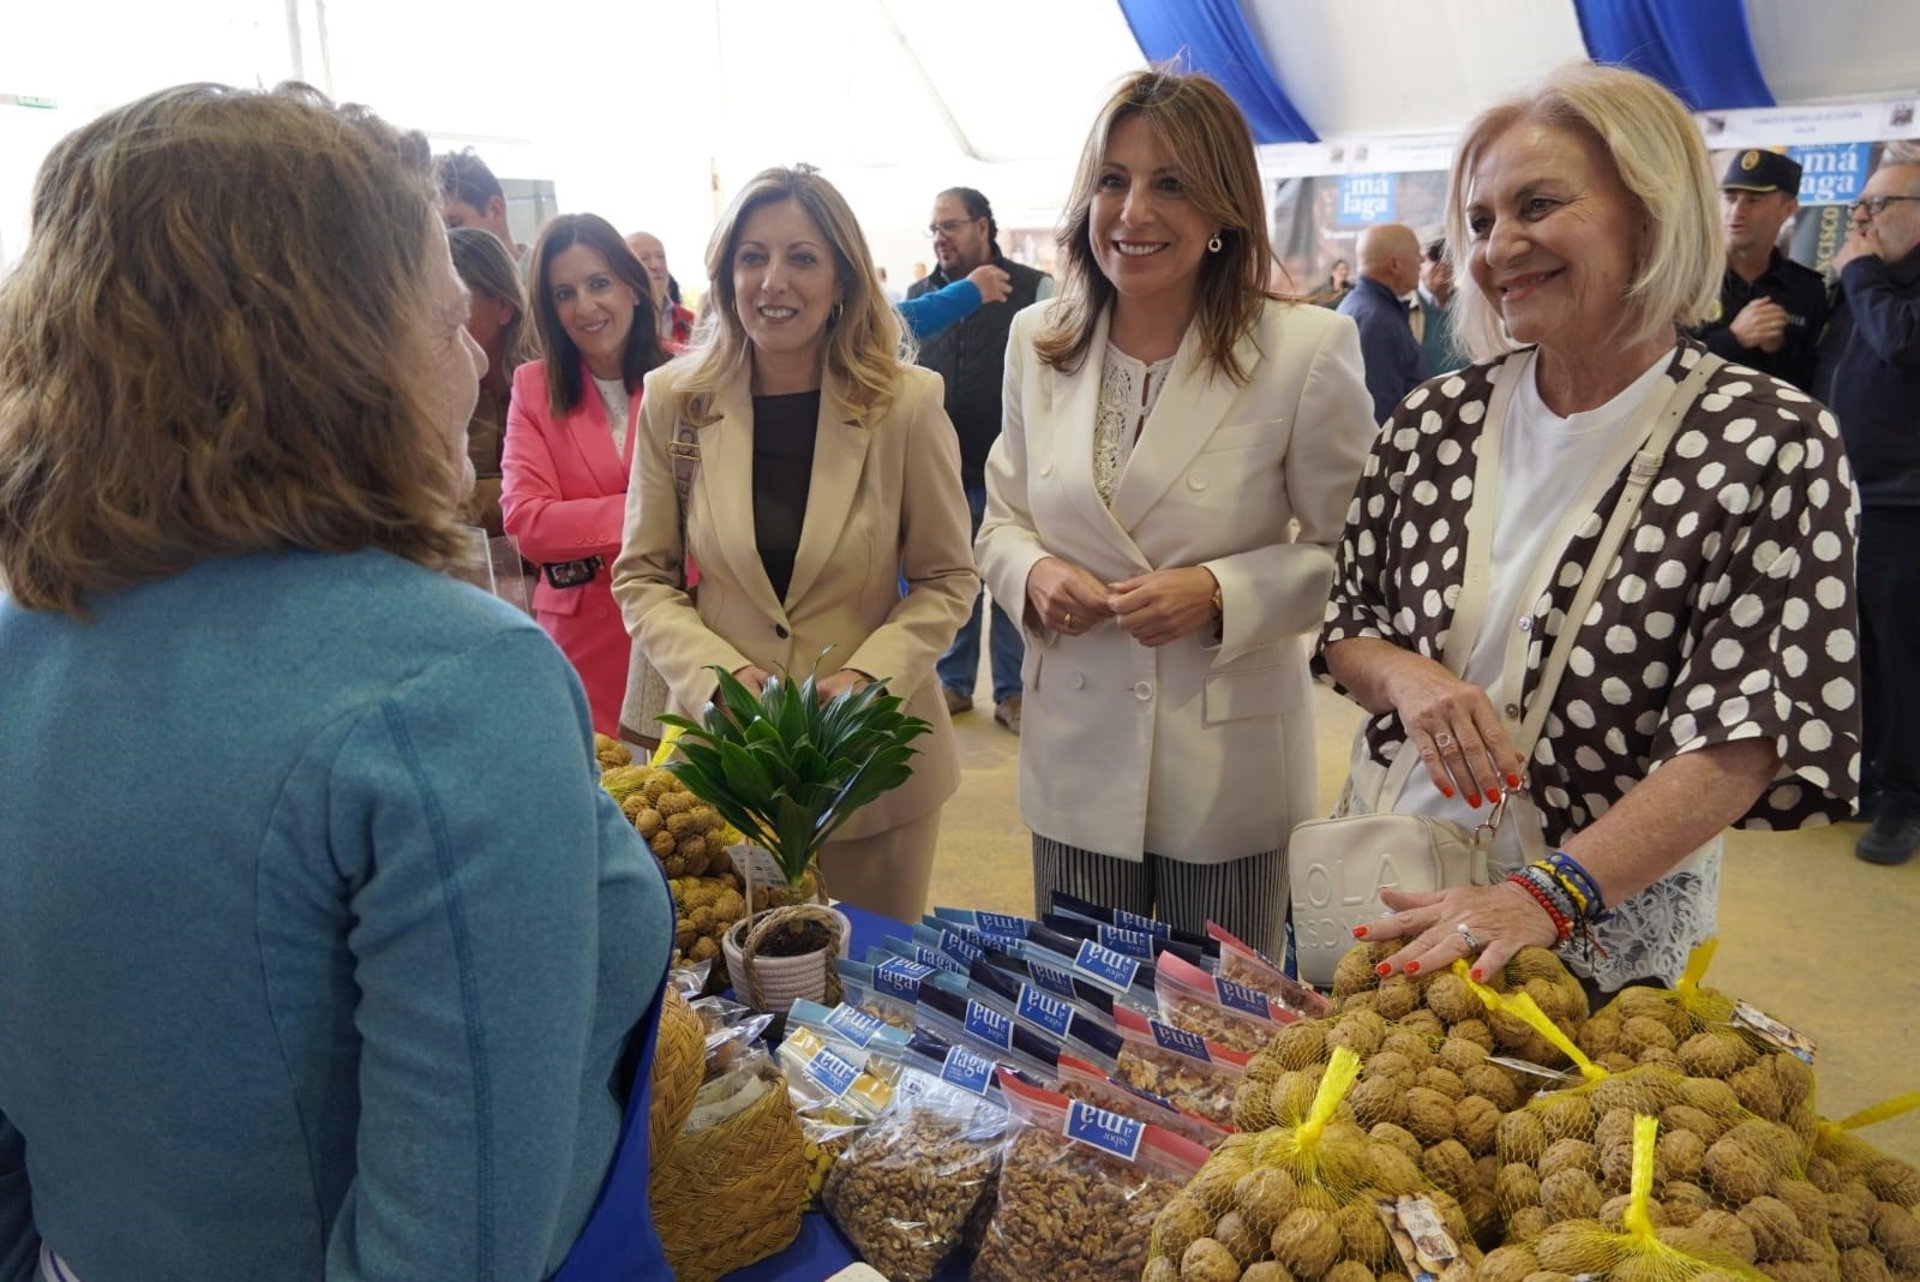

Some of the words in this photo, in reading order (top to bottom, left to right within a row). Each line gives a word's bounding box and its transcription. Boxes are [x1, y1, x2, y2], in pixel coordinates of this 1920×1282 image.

[1802, 143, 1858, 173] má
[1800, 175, 1855, 201] aga
[1344, 192, 1388, 220] laga
[1085, 943, 1123, 970] má
[877, 968, 913, 991] laga
[972, 1001, 1001, 1030] má
[1026, 988, 1059, 1017] má
[952, 1045, 987, 1077] laga
[1079, 1103, 1125, 1134] má
